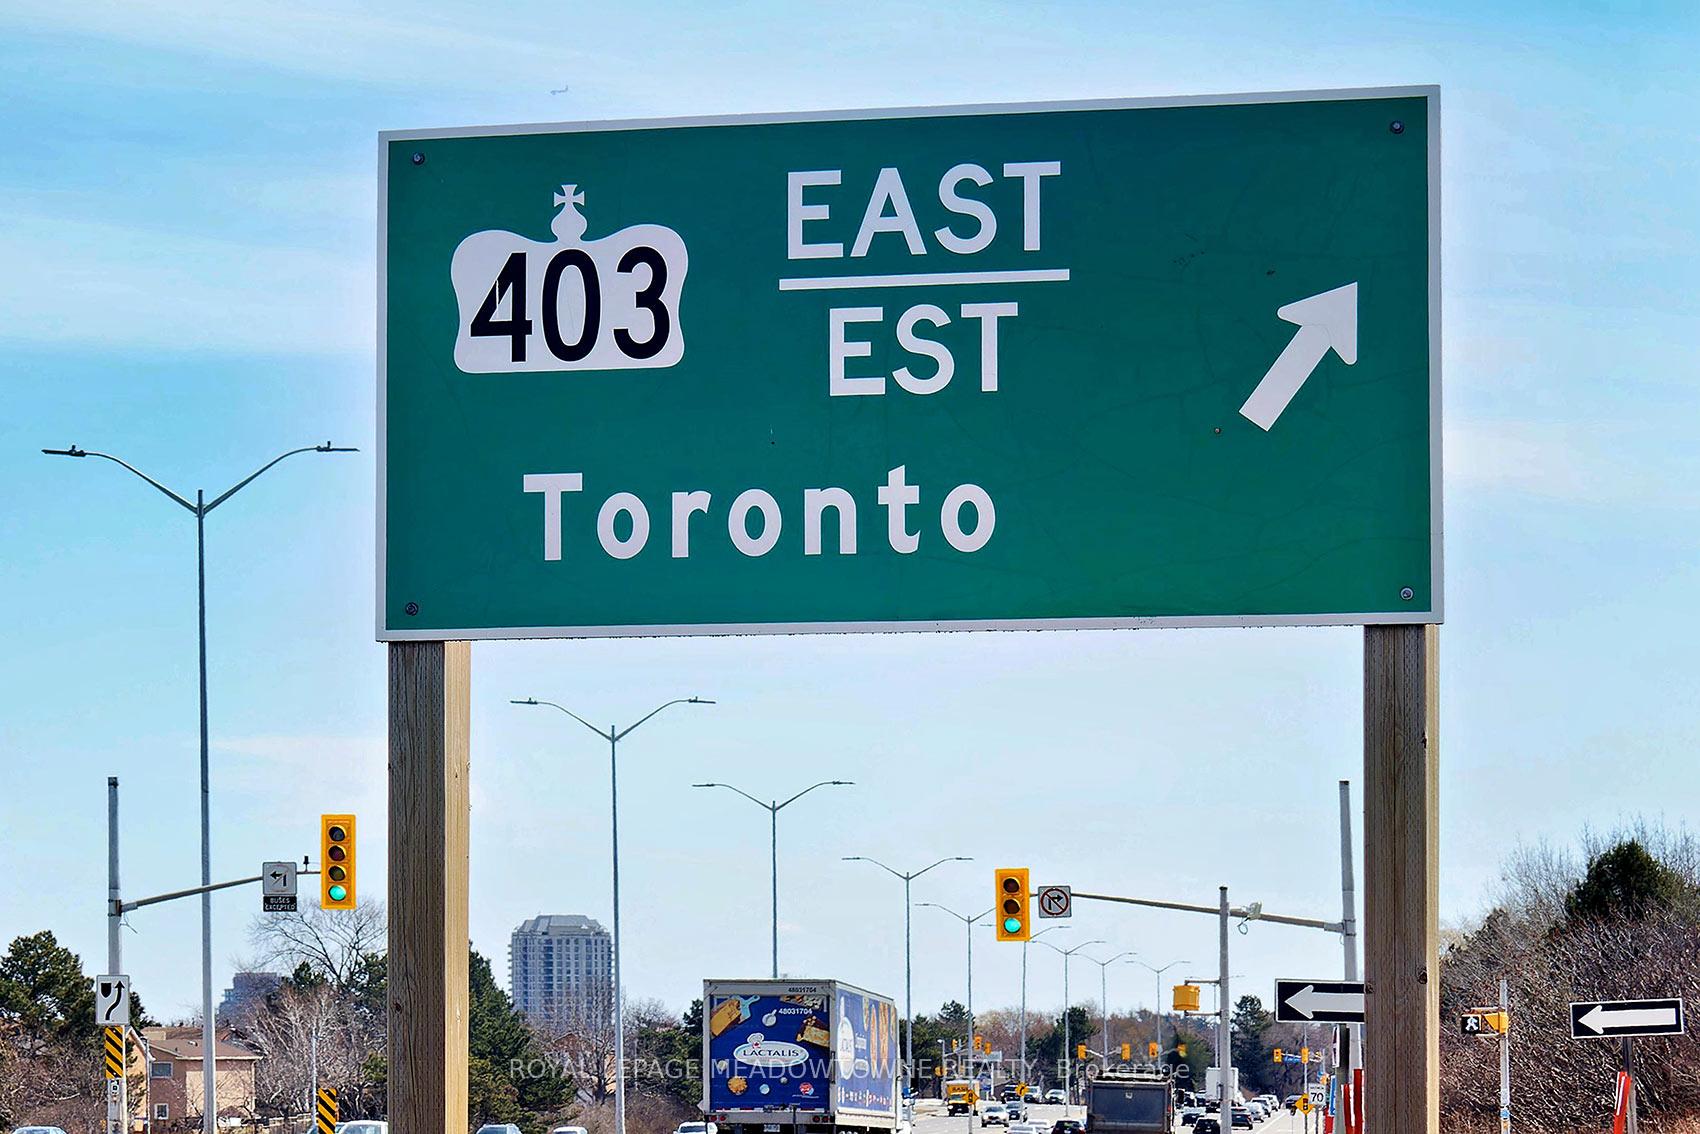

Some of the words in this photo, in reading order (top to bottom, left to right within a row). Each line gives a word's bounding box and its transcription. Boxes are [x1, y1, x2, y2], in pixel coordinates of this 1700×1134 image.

[787, 161, 1061, 259] EAST
[470, 245, 671, 363] 403
[830, 302, 1018, 396] EST
[523, 464, 996, 561] Toronto
[743, 1049, 799, 1057] LACTALIS
[1310, 1092, 1324, 1102] 70
